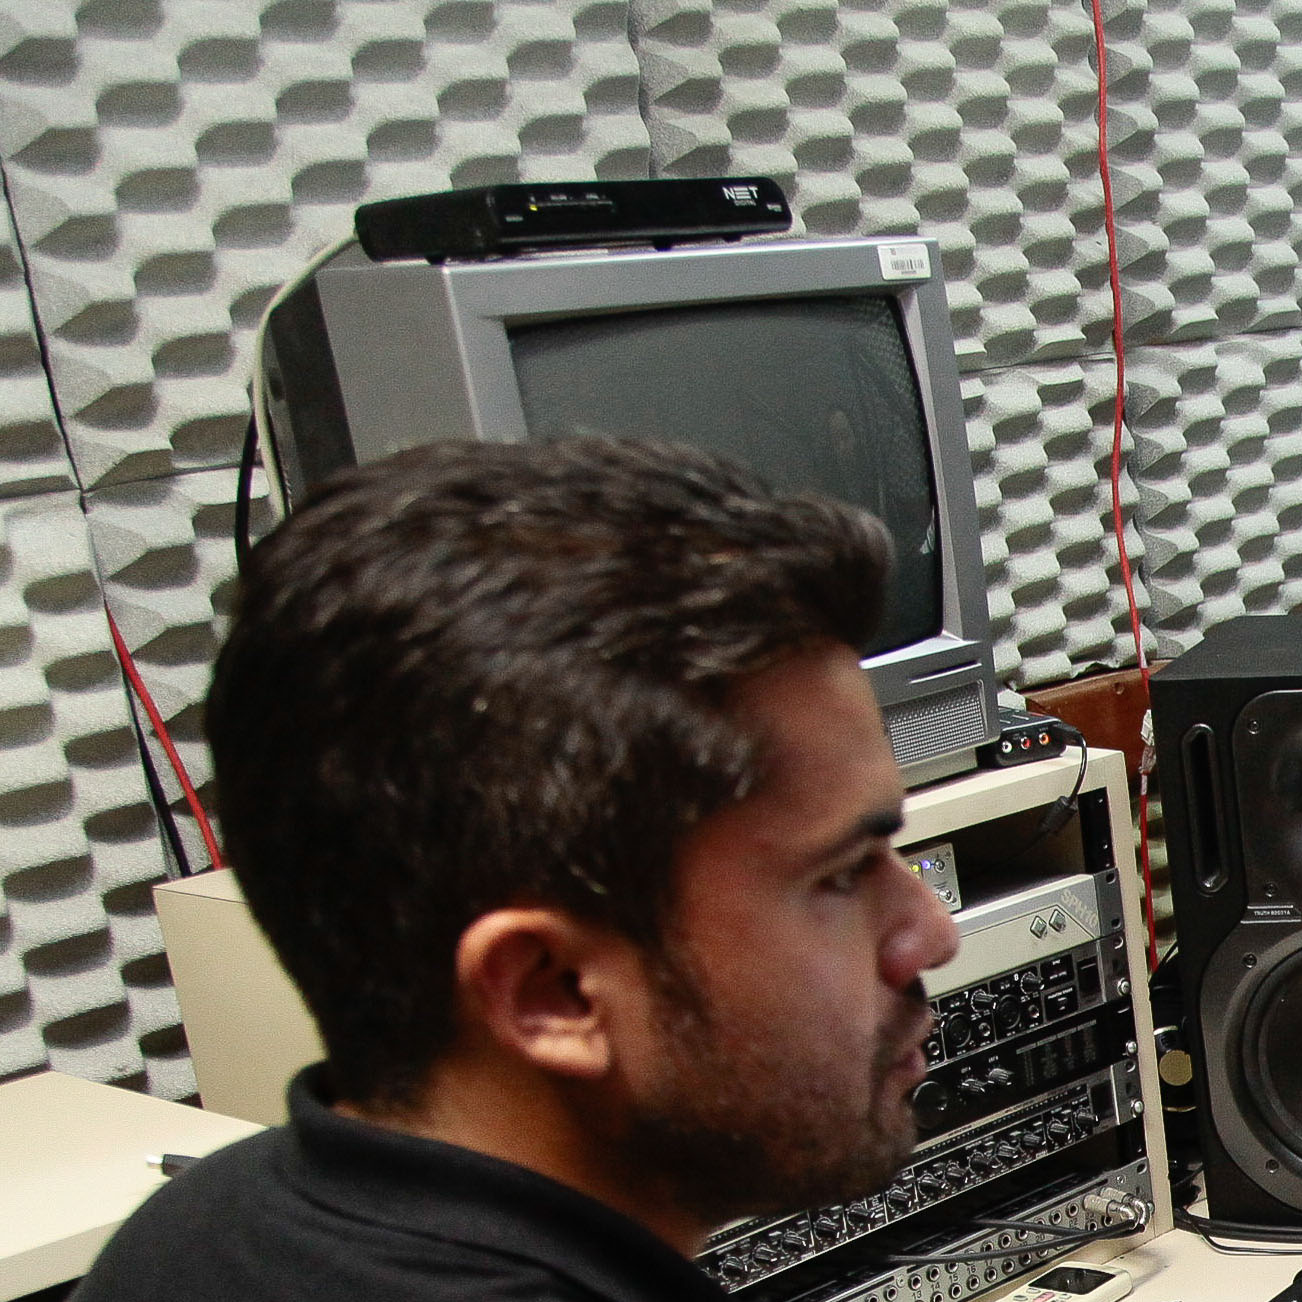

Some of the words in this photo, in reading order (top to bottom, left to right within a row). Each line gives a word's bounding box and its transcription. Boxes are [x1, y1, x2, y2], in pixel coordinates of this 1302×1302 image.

[722, 185, 760, 200] NET
[949, 1274, 958, 1282] 15
[912, 1291, 922, 1299] 13
